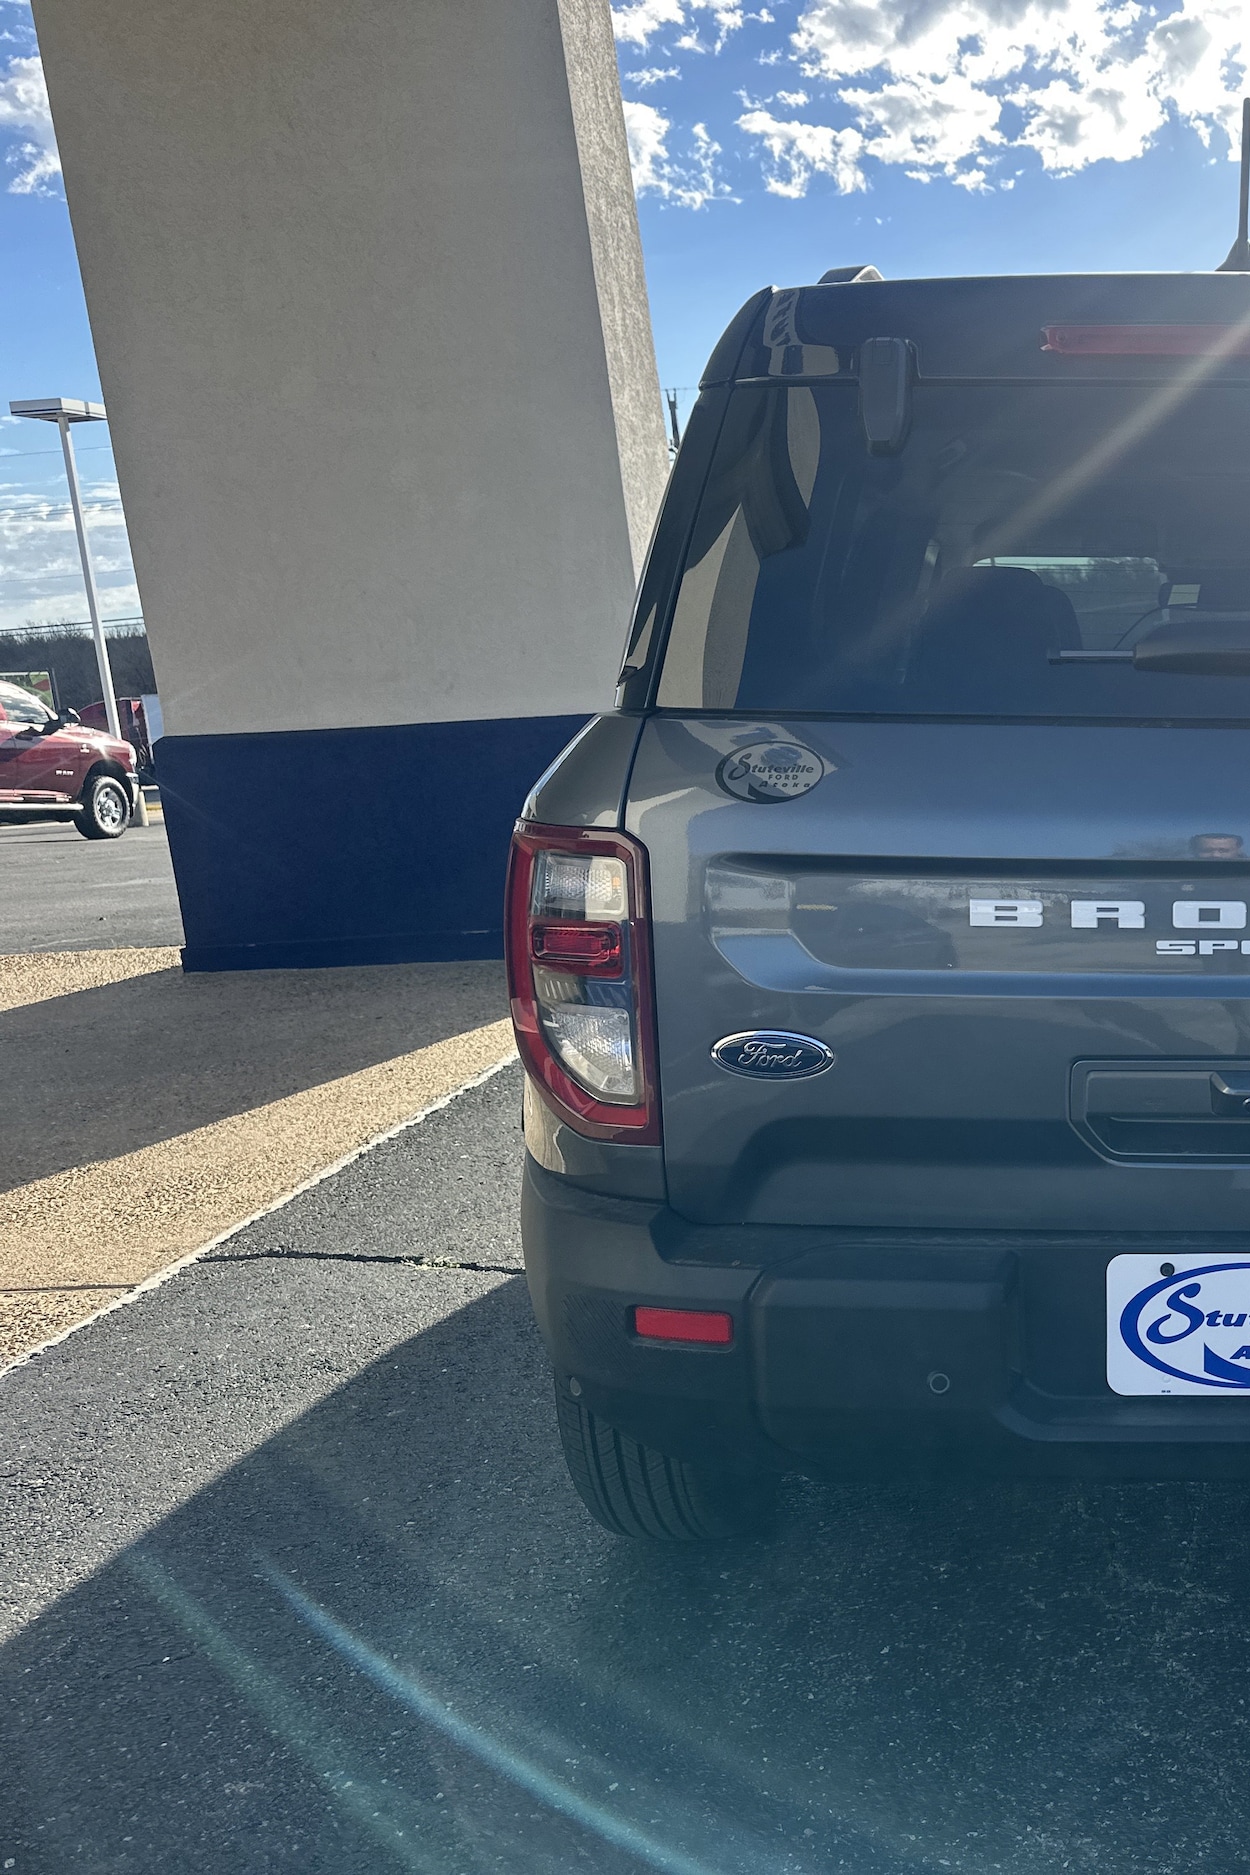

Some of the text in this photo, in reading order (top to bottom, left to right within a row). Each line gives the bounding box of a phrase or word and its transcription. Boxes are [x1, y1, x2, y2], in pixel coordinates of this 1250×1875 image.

[728, 753, 815, 781] Stuteville
[758, 780, 811, 788] Atoka
[737, 1041, 803, 1068] Ford
